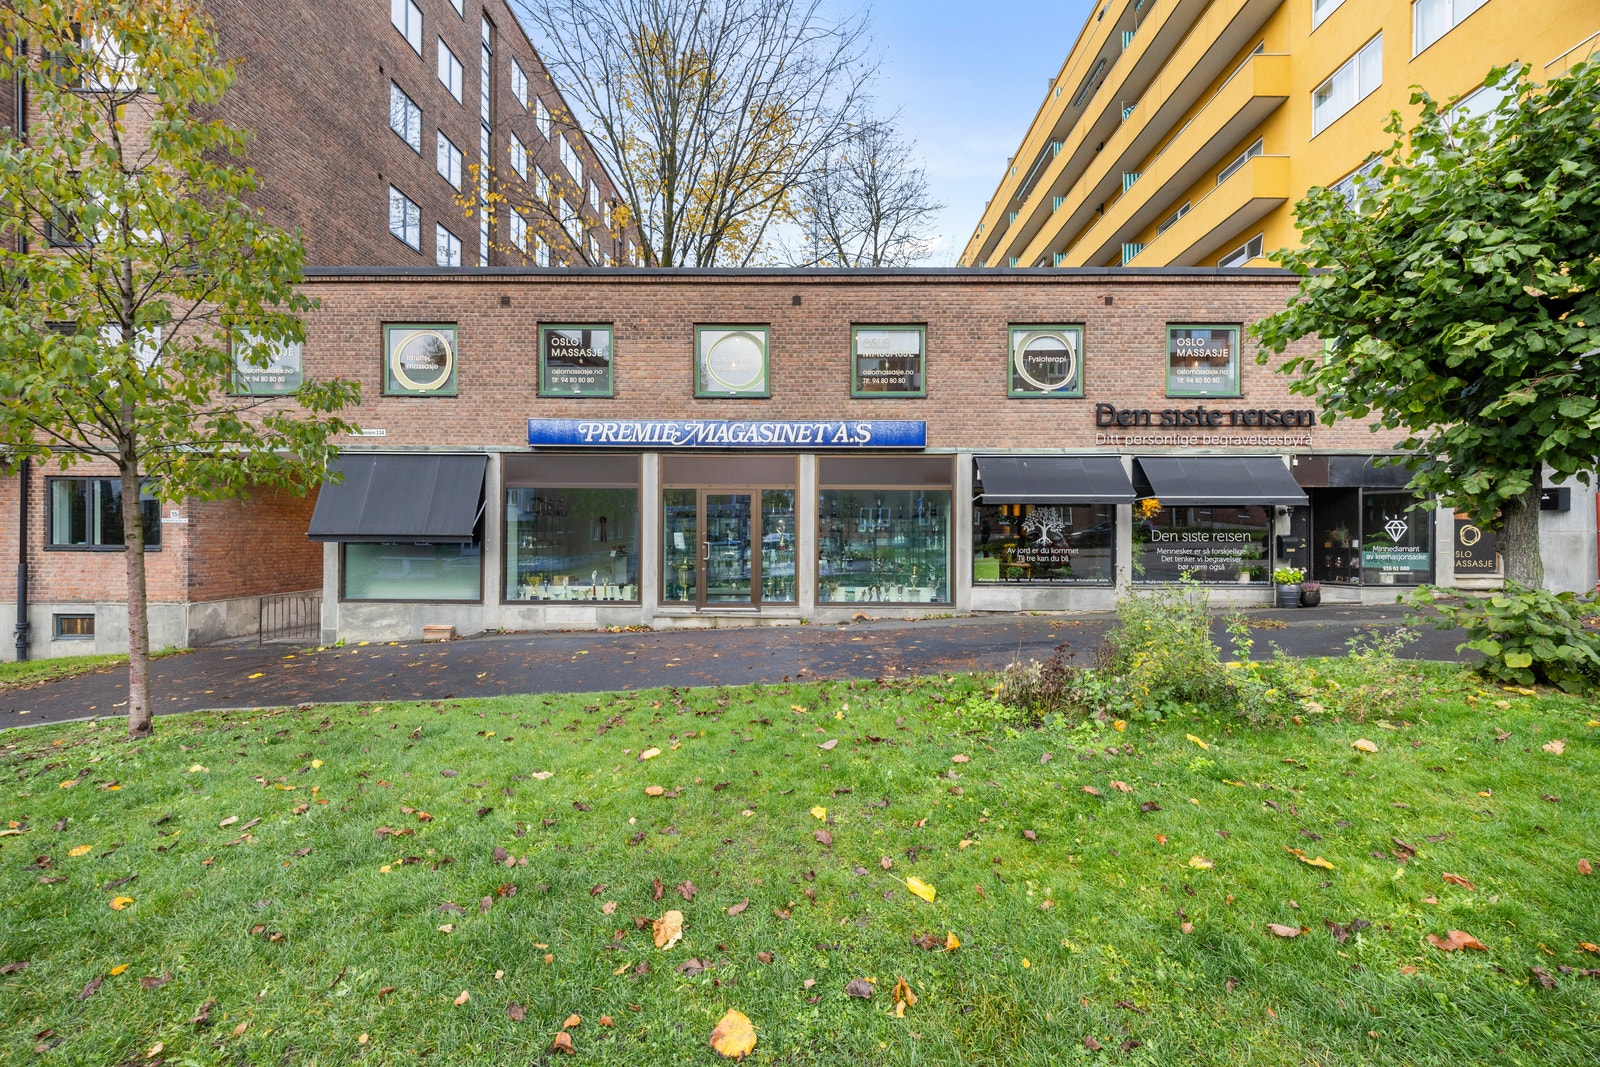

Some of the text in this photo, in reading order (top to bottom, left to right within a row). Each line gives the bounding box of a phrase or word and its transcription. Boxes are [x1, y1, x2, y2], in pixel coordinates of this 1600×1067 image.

[551, 337, 579, 346] OSLO
[1176, 337, 1205, 347] OSLO
[551, 348, 603, 357] MASSASJE
[1176, 348, 1229, 358] MASSASJE
[1028, 355, 1067, 364] Fysioterapi
[406, 363, 439, 371] massasje
[551, 368, 603, 376] oslomassasje.no
[862, 369, 915, 377] oslomassasje.no
[1176, 368, 1229, 376] oslomassasje.no
[1095, 402, 1153, 427] Den
[1095, 432, 1313, 450] Ditt personlige begravelsesbyrå
[1151, 530, 1179, 541] Den
[1017, 547, 1030, 555] jord
[1455, 550, 1473, 558] SLO
[1161, 555, 1173, 563] Det
[1174, 555, 1196, 563] tenker
[1204, 555, 1242, 565] begravelser
[1375, 553, 1427, 562] kremasjonsaske
[1208, 563, 1225, 572] også
[1455, 560, 1493, 568] ASSASJE
